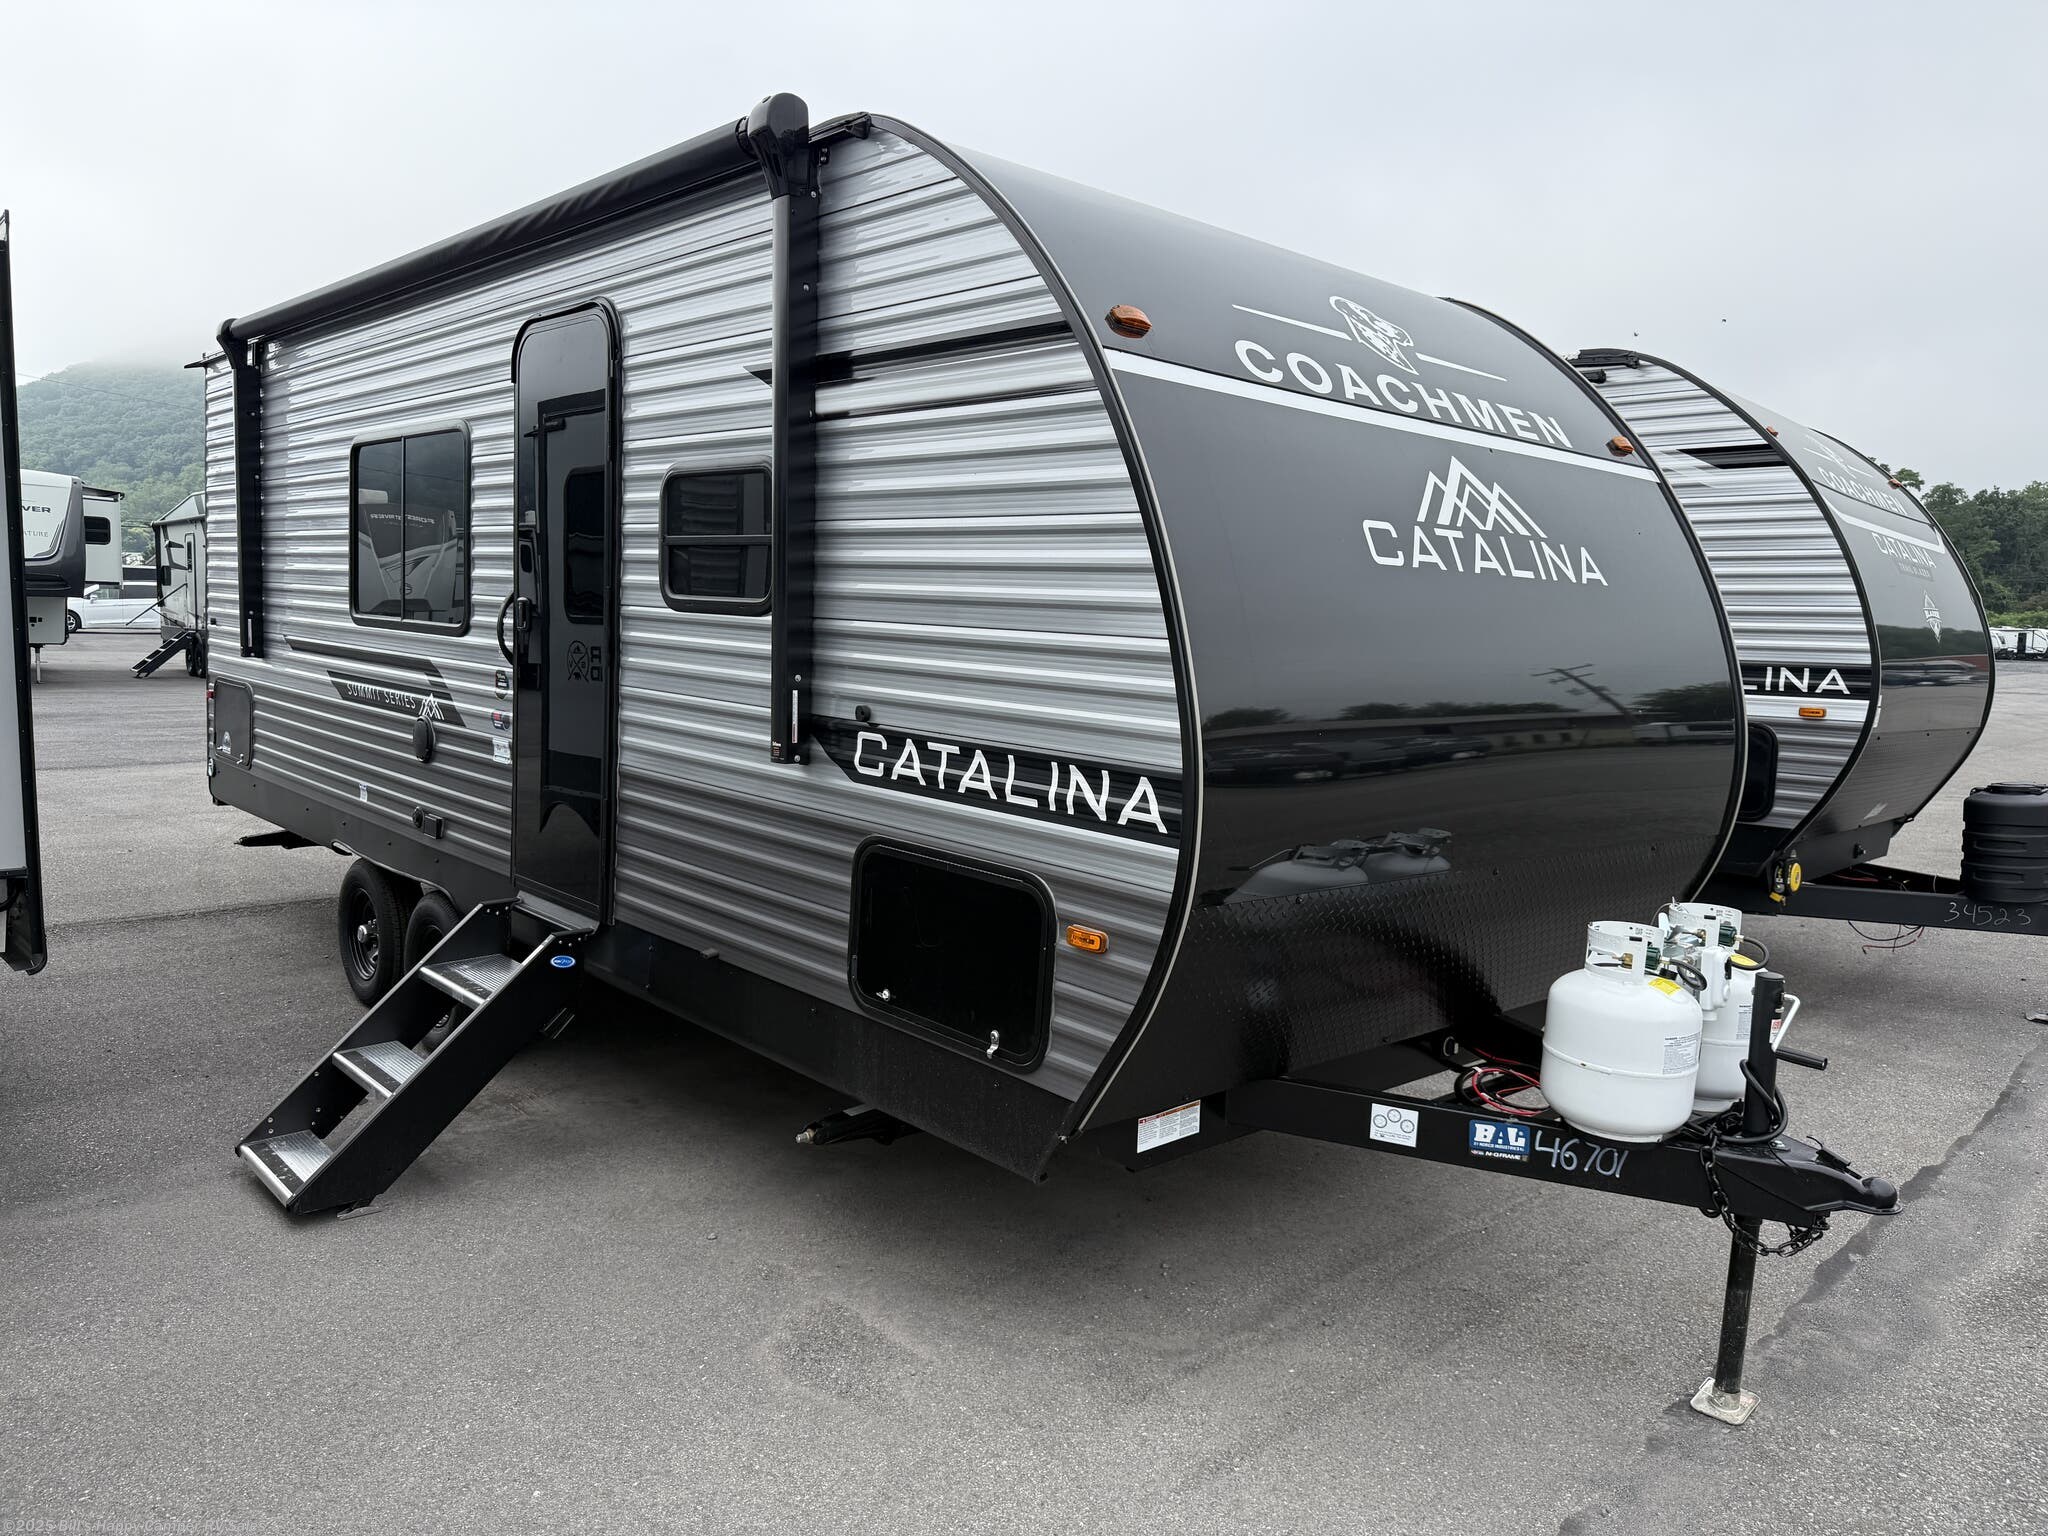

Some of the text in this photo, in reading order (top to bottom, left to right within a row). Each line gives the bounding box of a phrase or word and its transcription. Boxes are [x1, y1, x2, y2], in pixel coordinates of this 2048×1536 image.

[1234, 340, 1572, 448] COACHMEN
[21, 505, 51, 513] VER
[1818, 467, 1908, 516] COACHMEN
[1362, 519, 1608, 586] CATALINA
[1872, 532, 1937, 569] CATALINA
[346, 682, 416, 709] SUMMIT SERIES
[853, 731, 1168, 834] CATALINA
[1944, 901, 2032, 926] 34523
[1535, 1130, 1629, 1178] 46701
